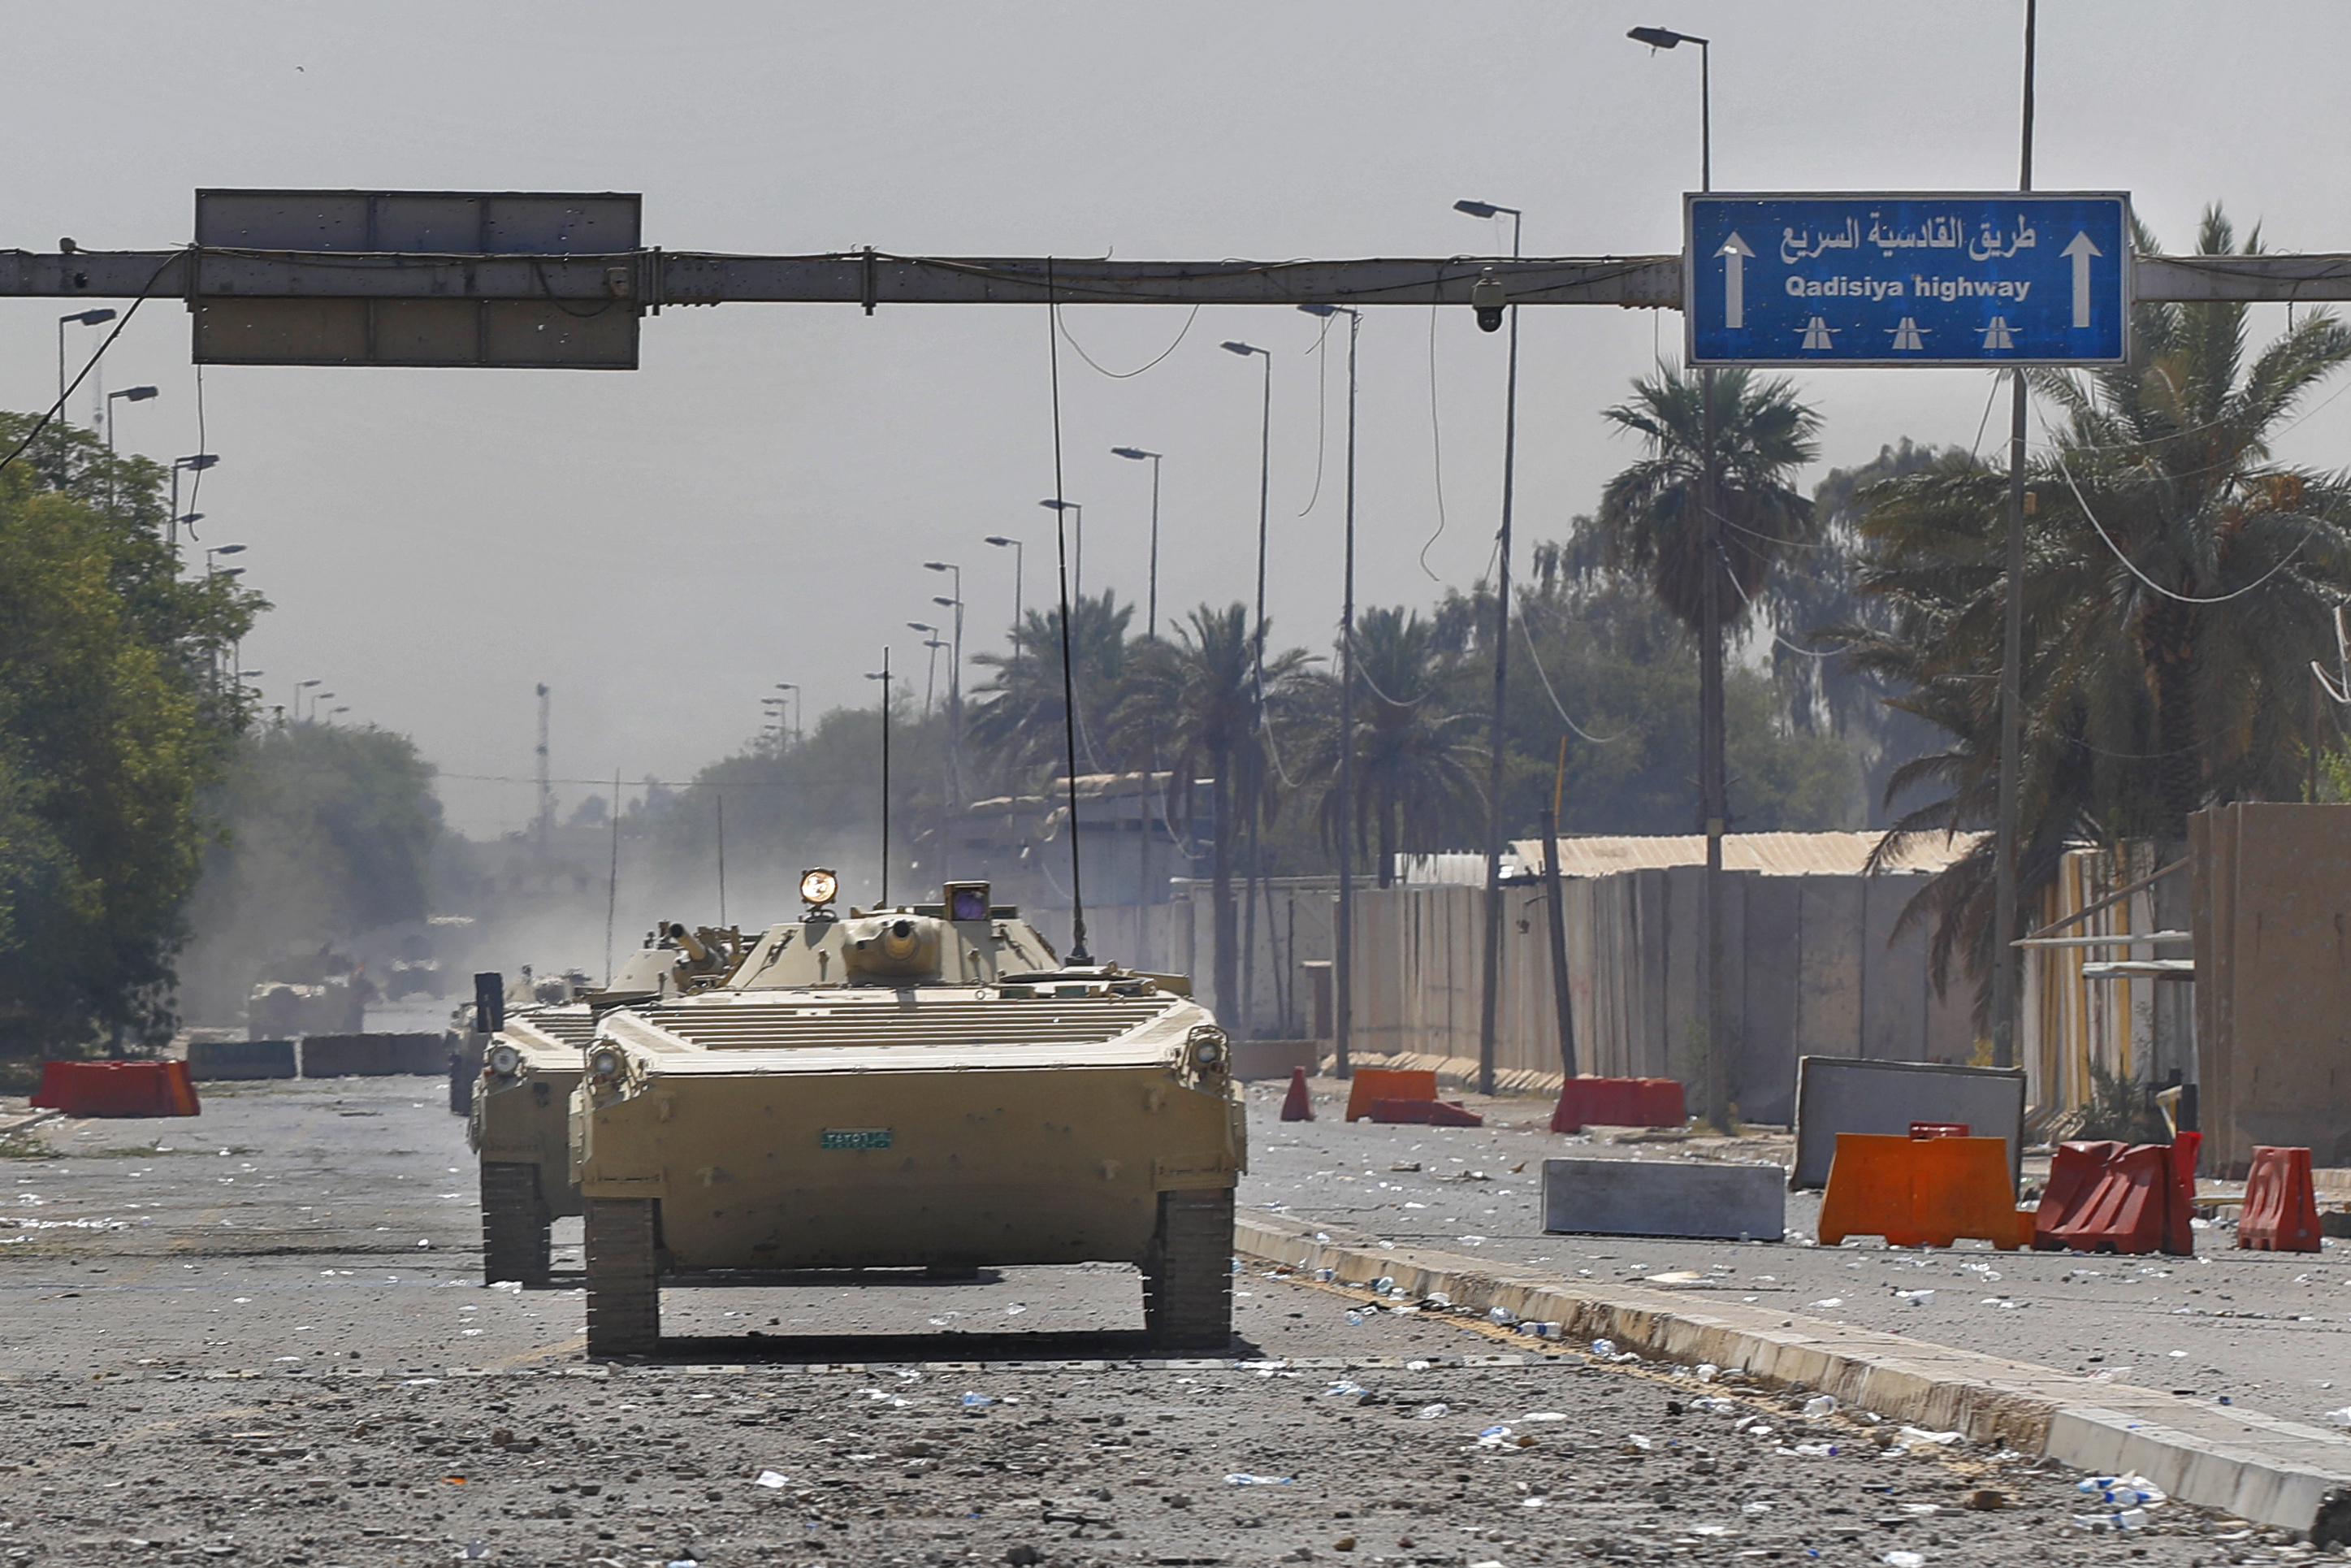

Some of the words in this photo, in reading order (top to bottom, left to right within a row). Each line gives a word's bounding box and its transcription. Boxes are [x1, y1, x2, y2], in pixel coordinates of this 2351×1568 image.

[1779, 215, 1860, 264] السريع
[1867, 211, 1963, 258] القادسية
[1968, 213, 2037, 262] طريق
[1785, 275, 1904, 302] Qadisiya
[1914, 275, 2031, 302] highway
